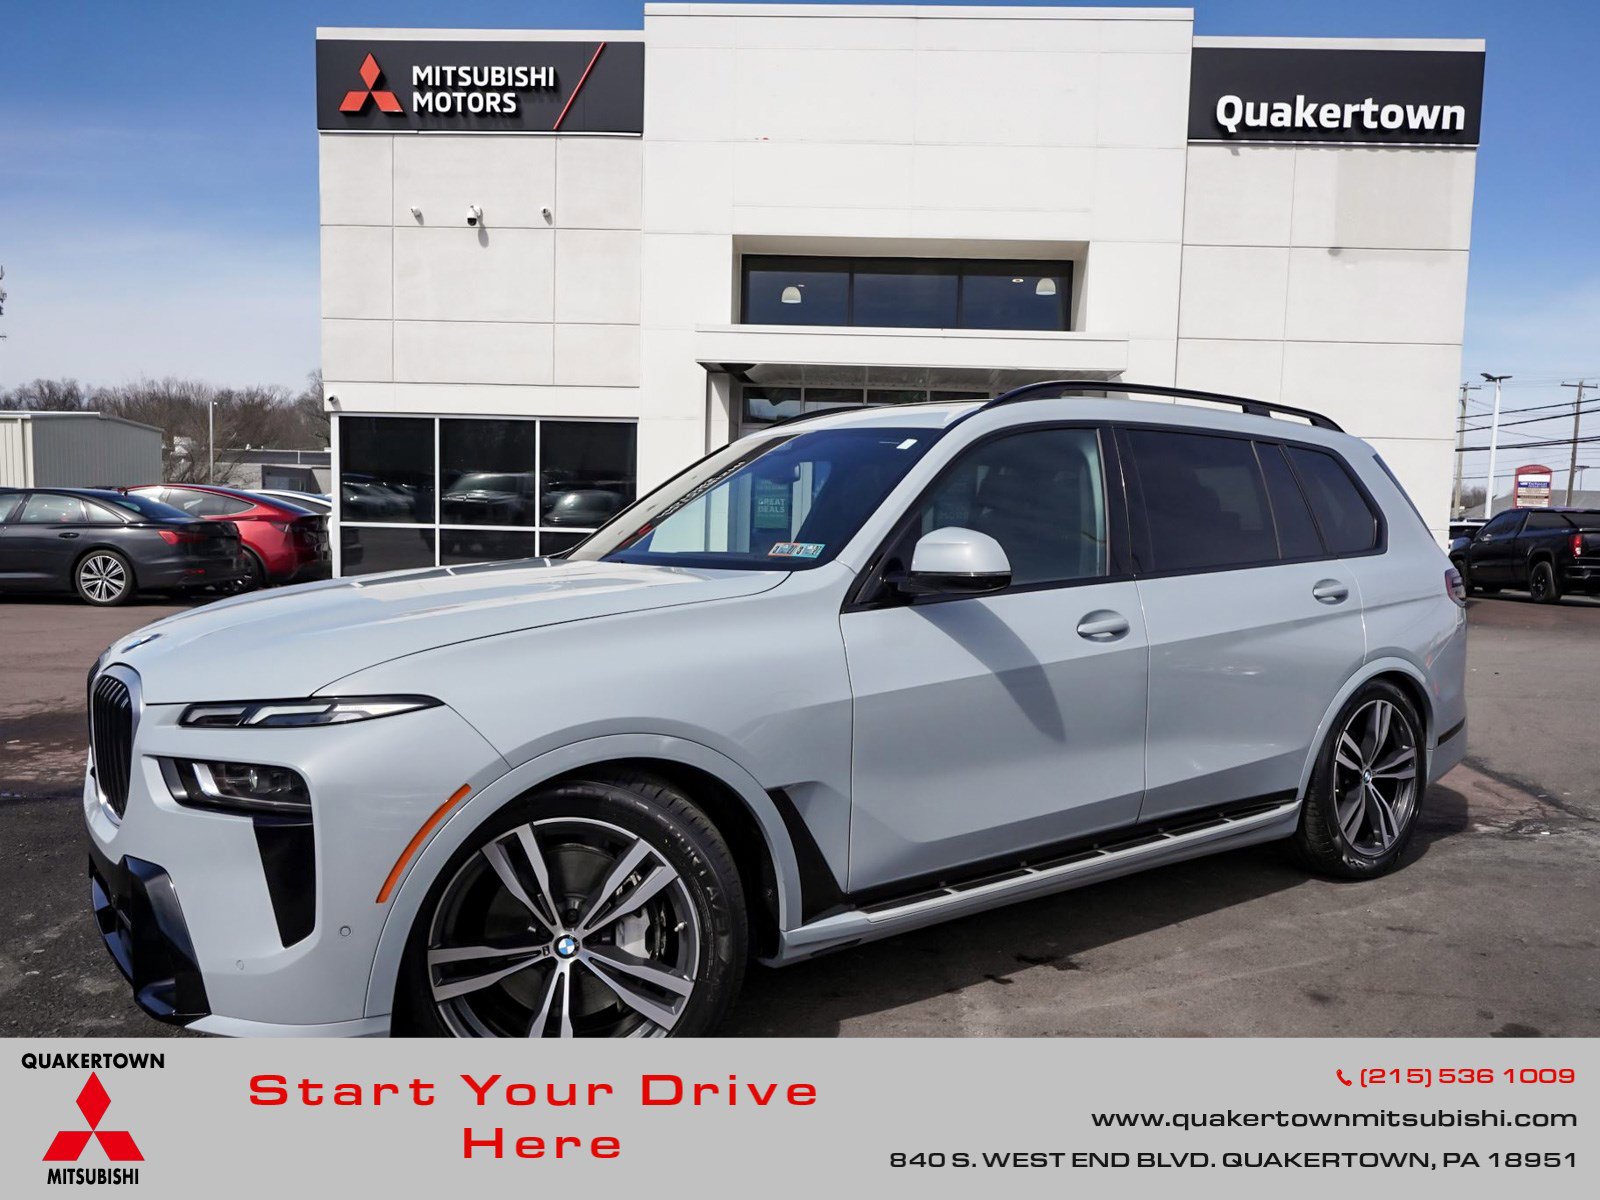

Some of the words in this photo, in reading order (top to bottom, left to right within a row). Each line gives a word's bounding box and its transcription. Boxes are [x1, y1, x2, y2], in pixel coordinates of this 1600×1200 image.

[412, 65, 555, 87] MITSUBISHI
[412, 91, 517, 113] MOTORS
[1216, 94, 1466, 133] Quakertown
[758, 498, 785, 506] GREAT
